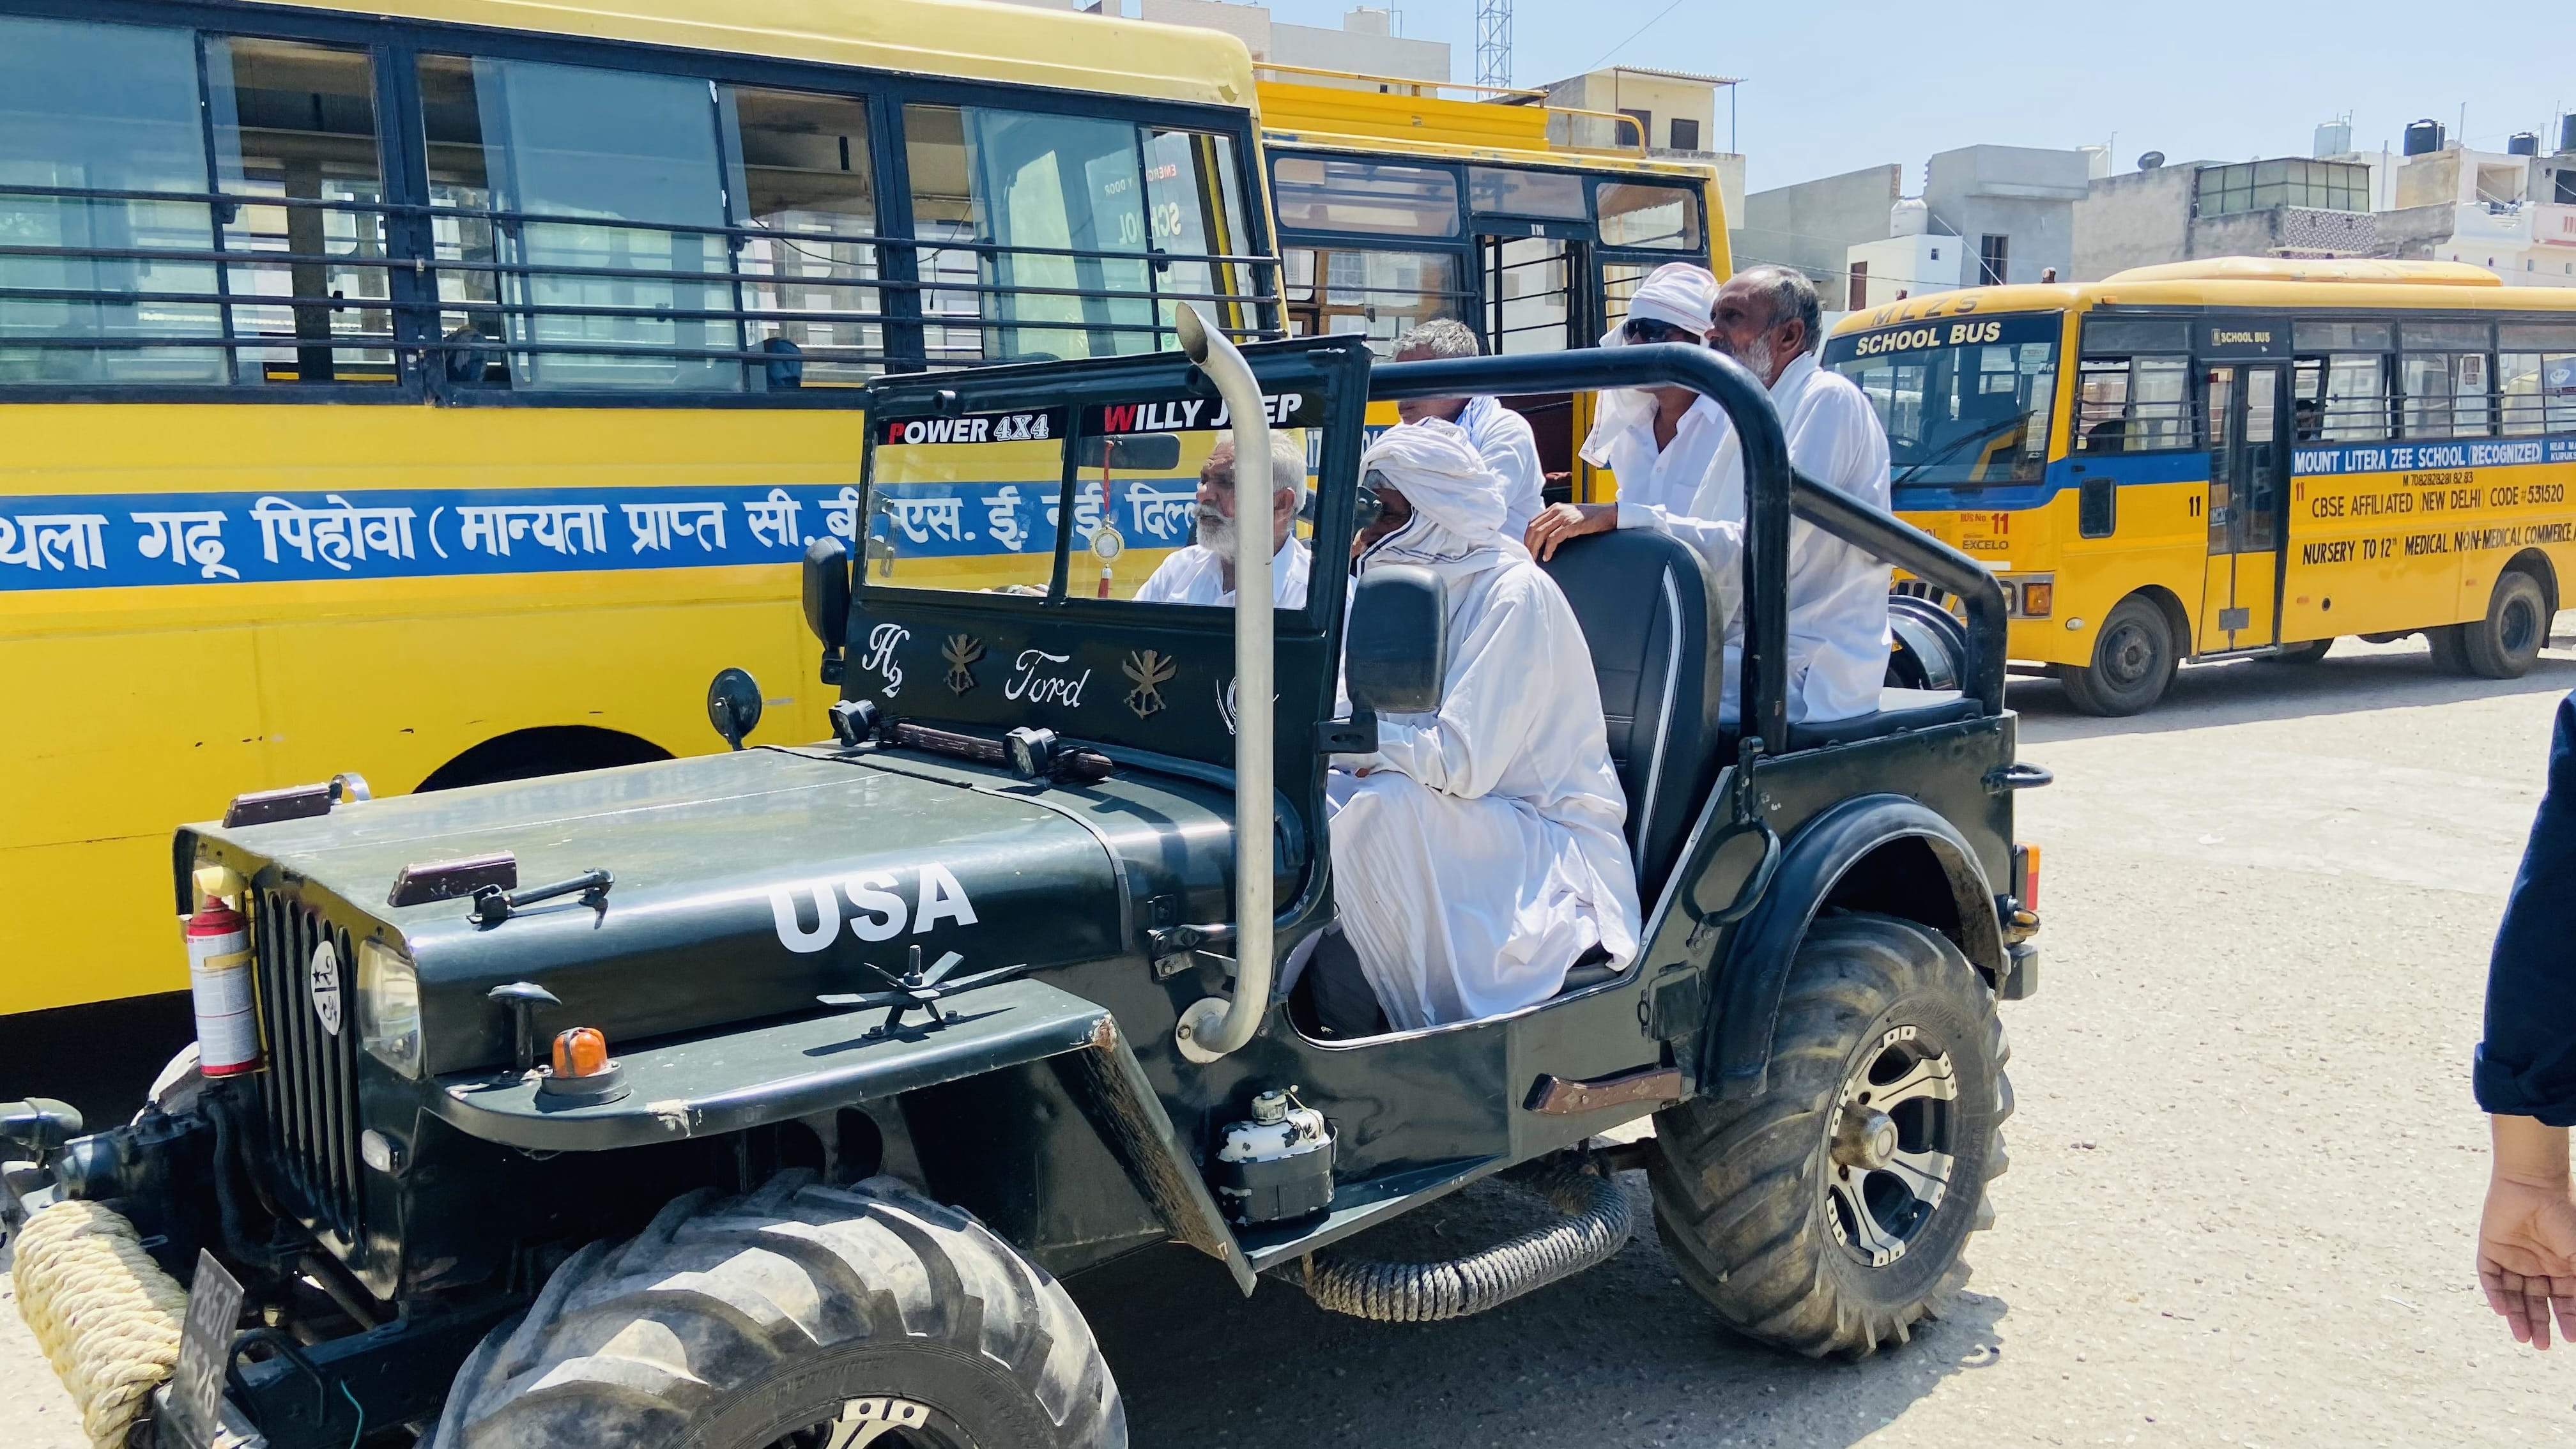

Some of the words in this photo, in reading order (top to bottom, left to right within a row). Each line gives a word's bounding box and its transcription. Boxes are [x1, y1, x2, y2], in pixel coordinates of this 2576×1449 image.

[1530, 224, 1545, 236] IN
[1855, 327, 1941, 356] SCHOOL
[1949, 321, 2002, 345] BUS
[2221, 332, 2253, 343] SCHOOL
[2254, 332, 2271, 343] BUS
[1104, 399, 1205, 433] WILLY
[1210, 393, 1303, 427] JEP
[888, 418, 989, 445] POWER
[993, 414, 1049, 441] 4X4
[2294, 451, 2341, 474] MOUNT
[2345, 448, 2387, 472] LITERA
[2390, 447, 2413, 469] ZEE
[2418, 445, 2465, 468] SCHOOL
[2189, 495, 2201, 517] 11
[2296, 482, 2305, 502] 11
[2312, 496, 2345, 518] CBSE
[2350, 492, 2413, 516] AFFILIATED
[2490, 486, 2519, 507] CODE
[620, 502, 728, 555] प्राप्त
[1991, 512, 2009, 535] 11
[2303, 540, 2356, 565] NURSERY
[2362, 539, 2377, 560] TO
[767, 861, 979, 953] USA
